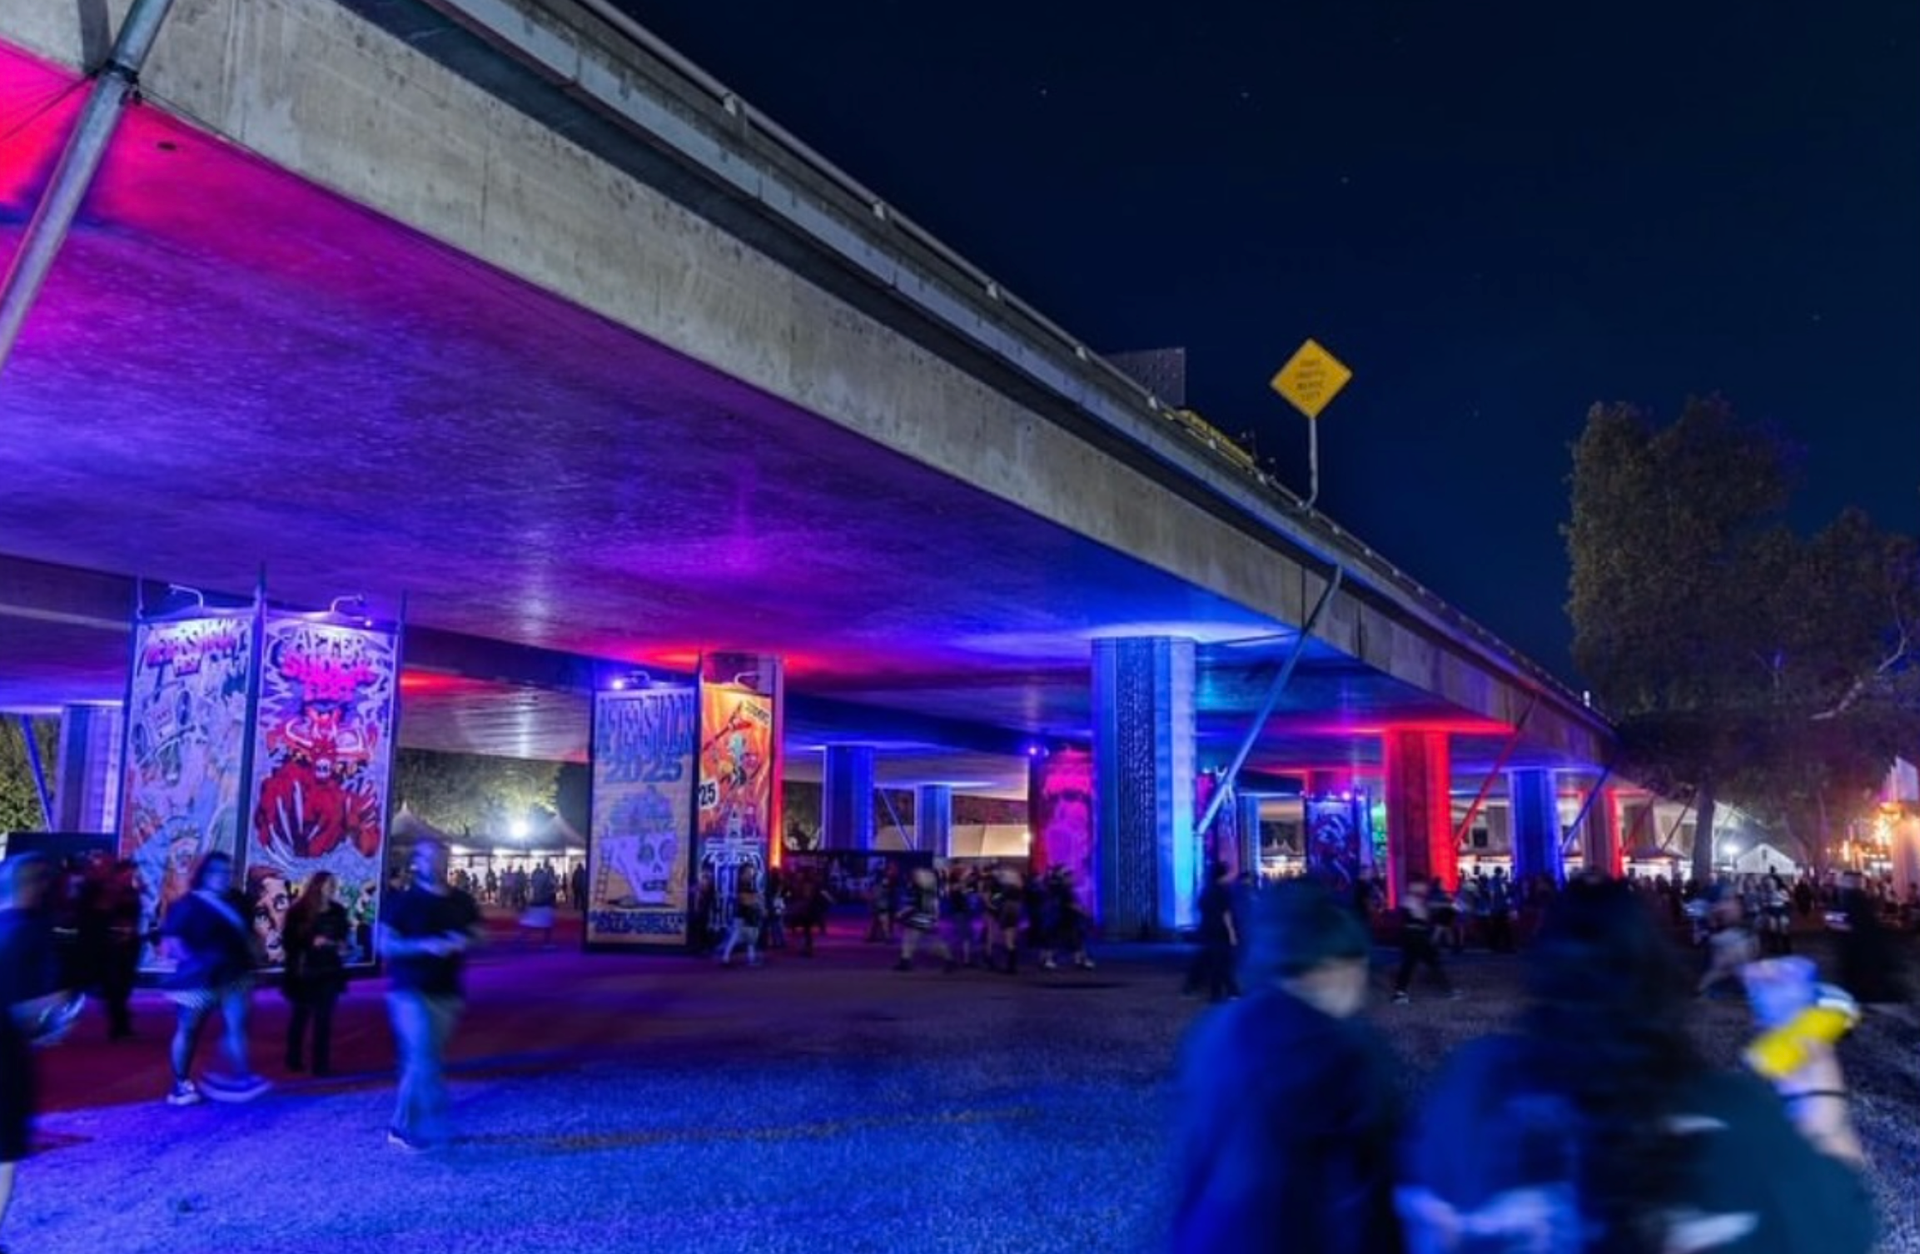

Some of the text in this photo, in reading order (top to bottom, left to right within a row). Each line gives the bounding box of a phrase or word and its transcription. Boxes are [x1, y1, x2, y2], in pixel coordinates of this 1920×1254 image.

[293, 628, 366, 660] AFTER
[604, 757, 683, 783] 2025
[699, 783, 716, 806] 25
